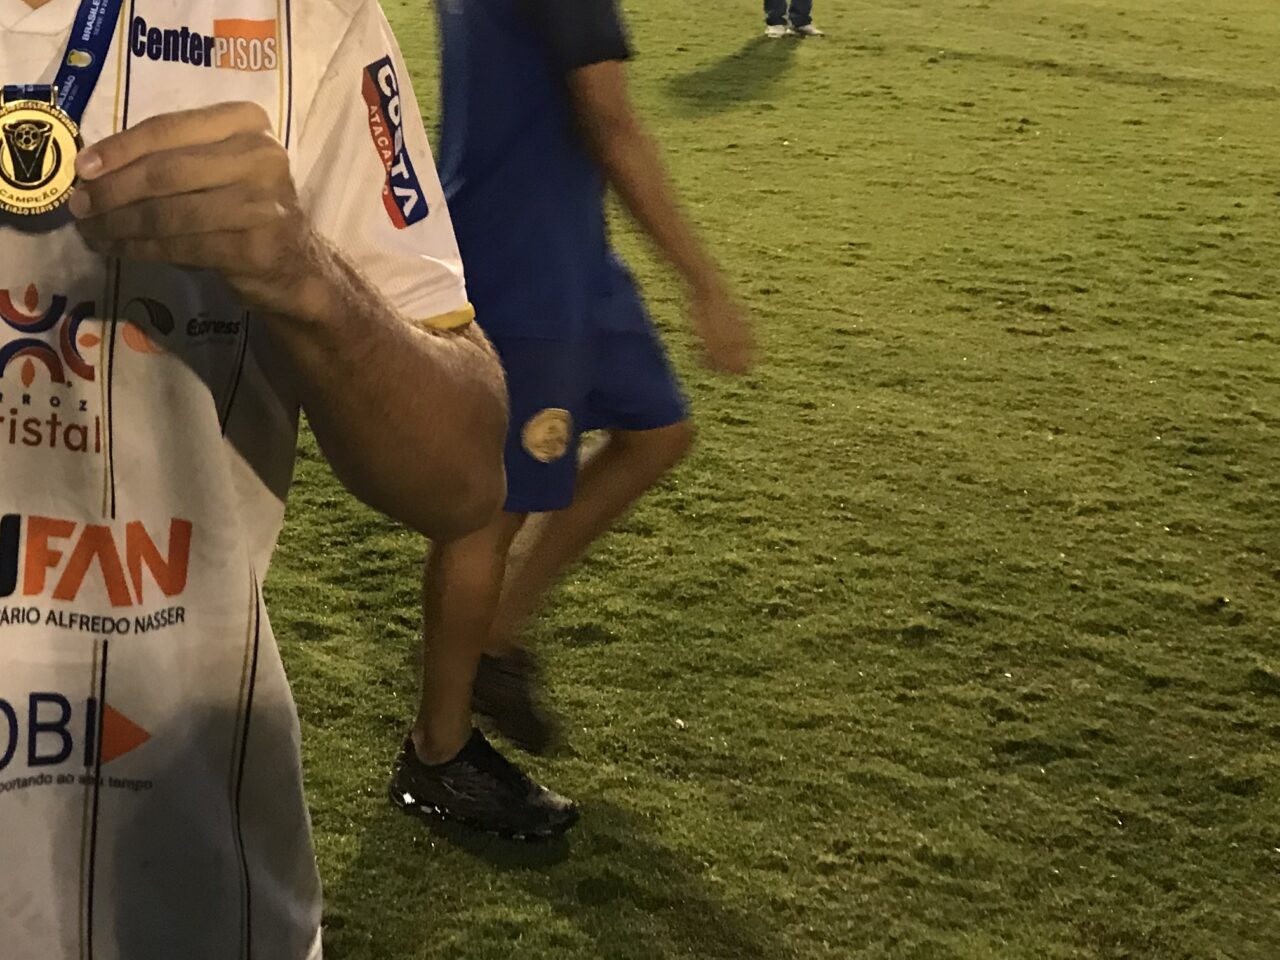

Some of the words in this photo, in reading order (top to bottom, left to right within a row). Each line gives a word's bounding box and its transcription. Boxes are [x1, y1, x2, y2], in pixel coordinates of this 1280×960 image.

[131, 16, 278, 71] CenterPISOS
[45, 610, 131, 635] ALFREDO
[134, 606, 186, 634] NASSER
[56, 774, 75, 786] ao
[108, 777, 153, 792] tempo
